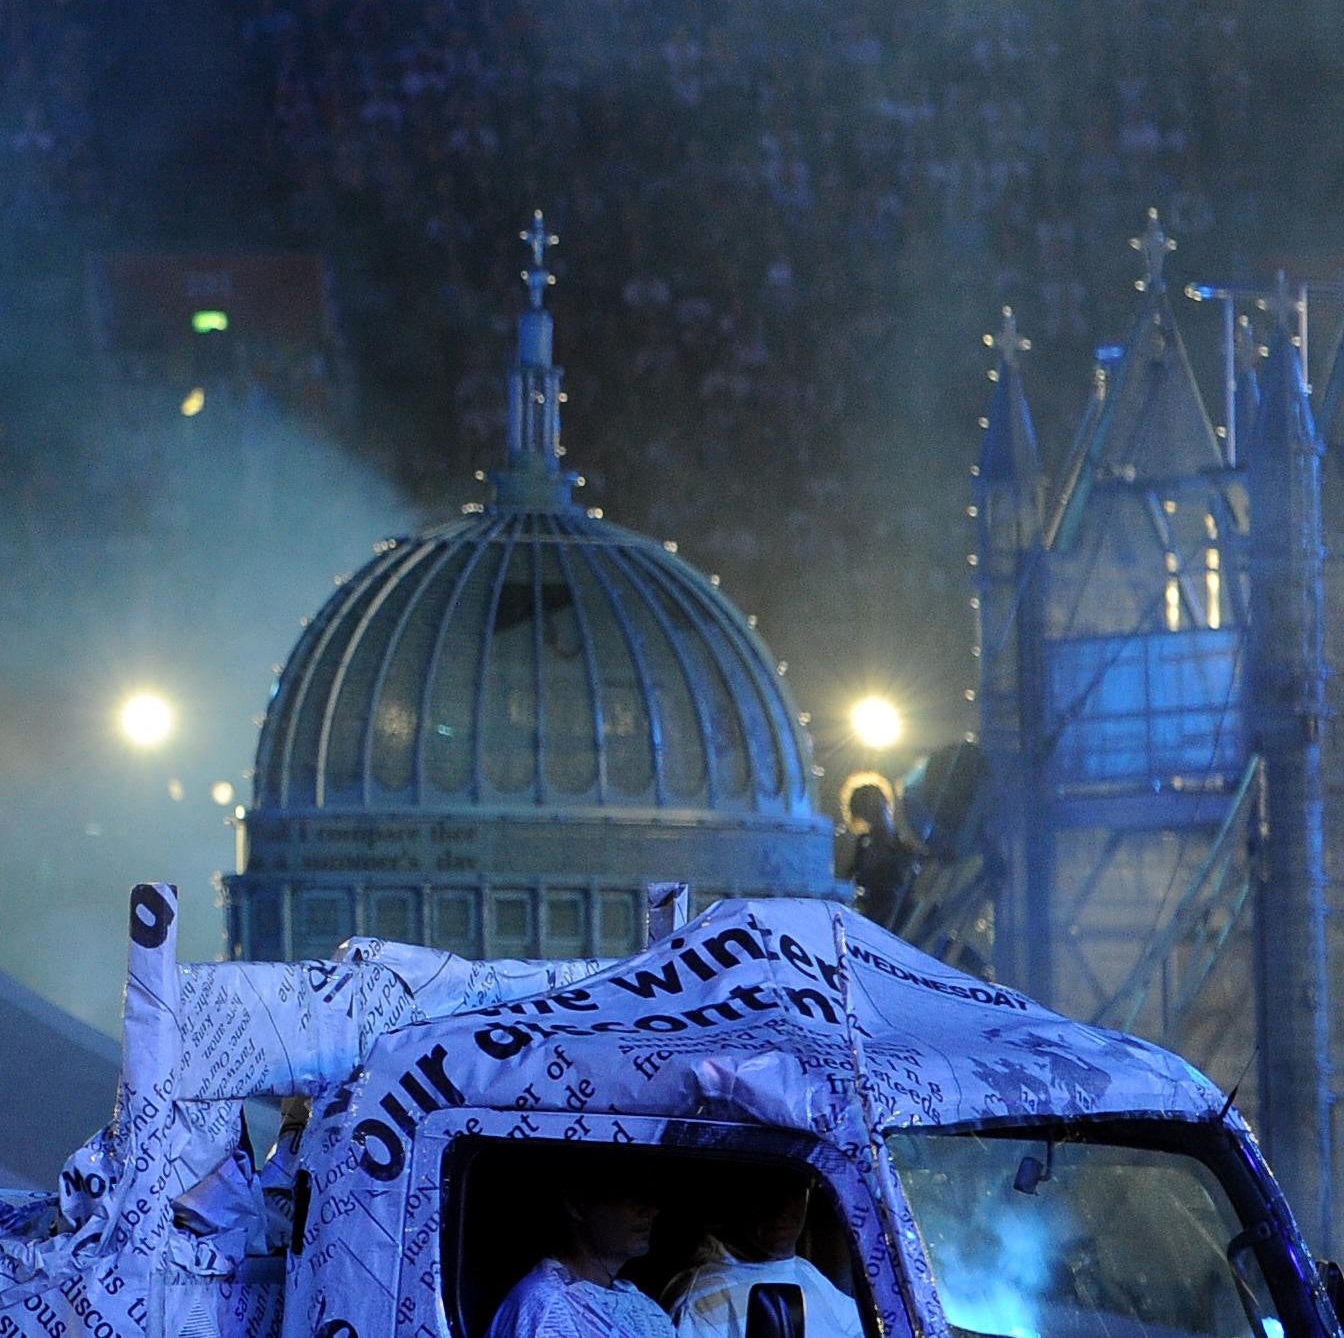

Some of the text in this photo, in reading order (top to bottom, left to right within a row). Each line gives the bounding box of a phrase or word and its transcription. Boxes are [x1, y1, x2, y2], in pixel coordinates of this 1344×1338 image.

[842, 942, 1033, 1013] WEDNESDAY
[191, 1013, 214, 1048] king
[209, 1051, 230, 1081] Our
[546, 1044, 575, 1080] of
[153, 1069, 175, 1103] for
[352, 1045, 466, 1182] our
[128, 1142, 156, 1173] of
[306, 1150, 364, 1195] Lord
[120, 1198, 152, 1229] be
[98, 1264, 125, 1295] is
